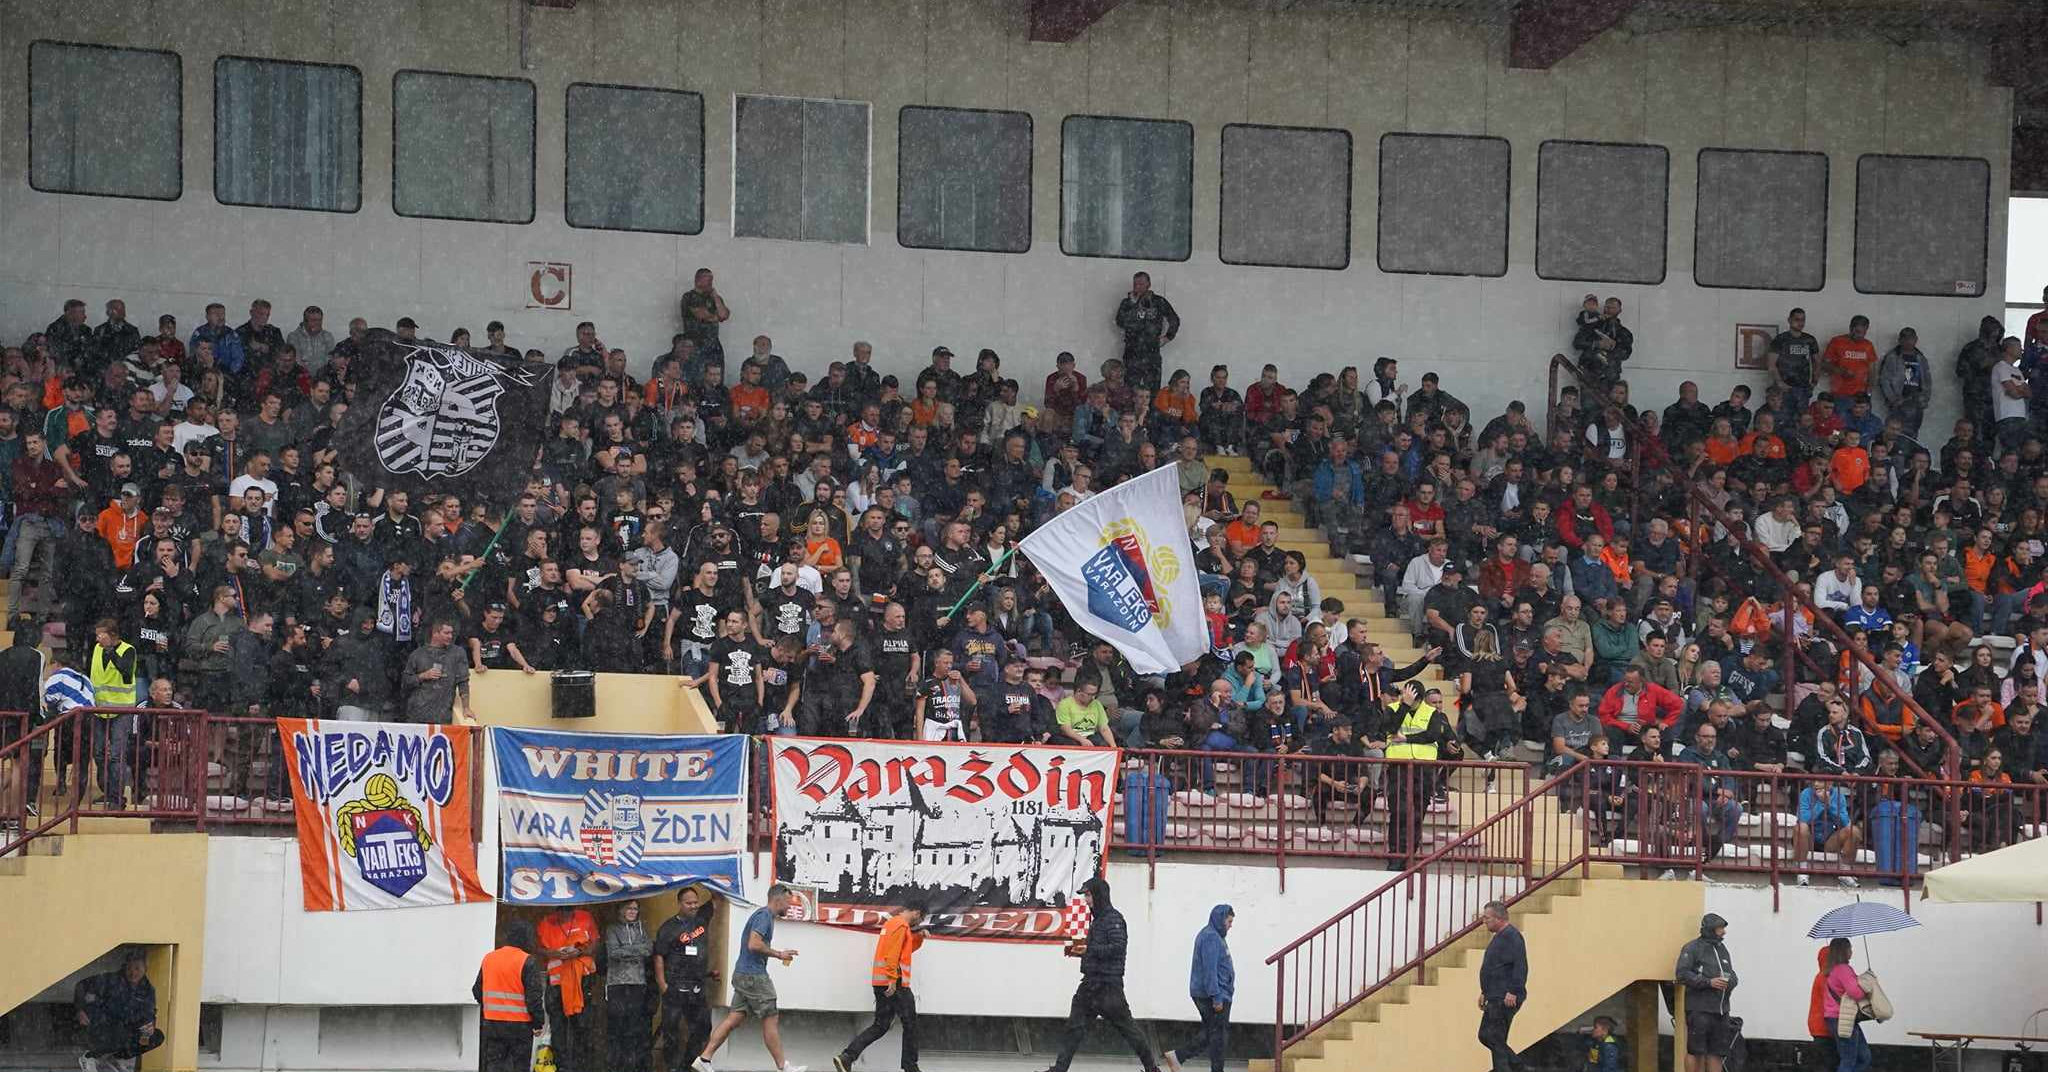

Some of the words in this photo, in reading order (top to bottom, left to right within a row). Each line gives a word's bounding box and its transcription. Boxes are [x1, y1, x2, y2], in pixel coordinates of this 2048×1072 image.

[531, 266, 565, 305] C
[1120, 537, 1138, 551] N
[294, 729, 453, 806] NEDAMO
[521, 745, 714, 783] WHITE
[775, 744, 1107, 812] Varaždin
[355, 816, 367, 828] N
[402, 813, 414, 826] K
[511, 807, 574, 842] VARA
[651, 808, 731, 845] ŽDIN
[1011, 800, 1043, 816] 1181
[360, 831, 421, 871] VARTEKS
